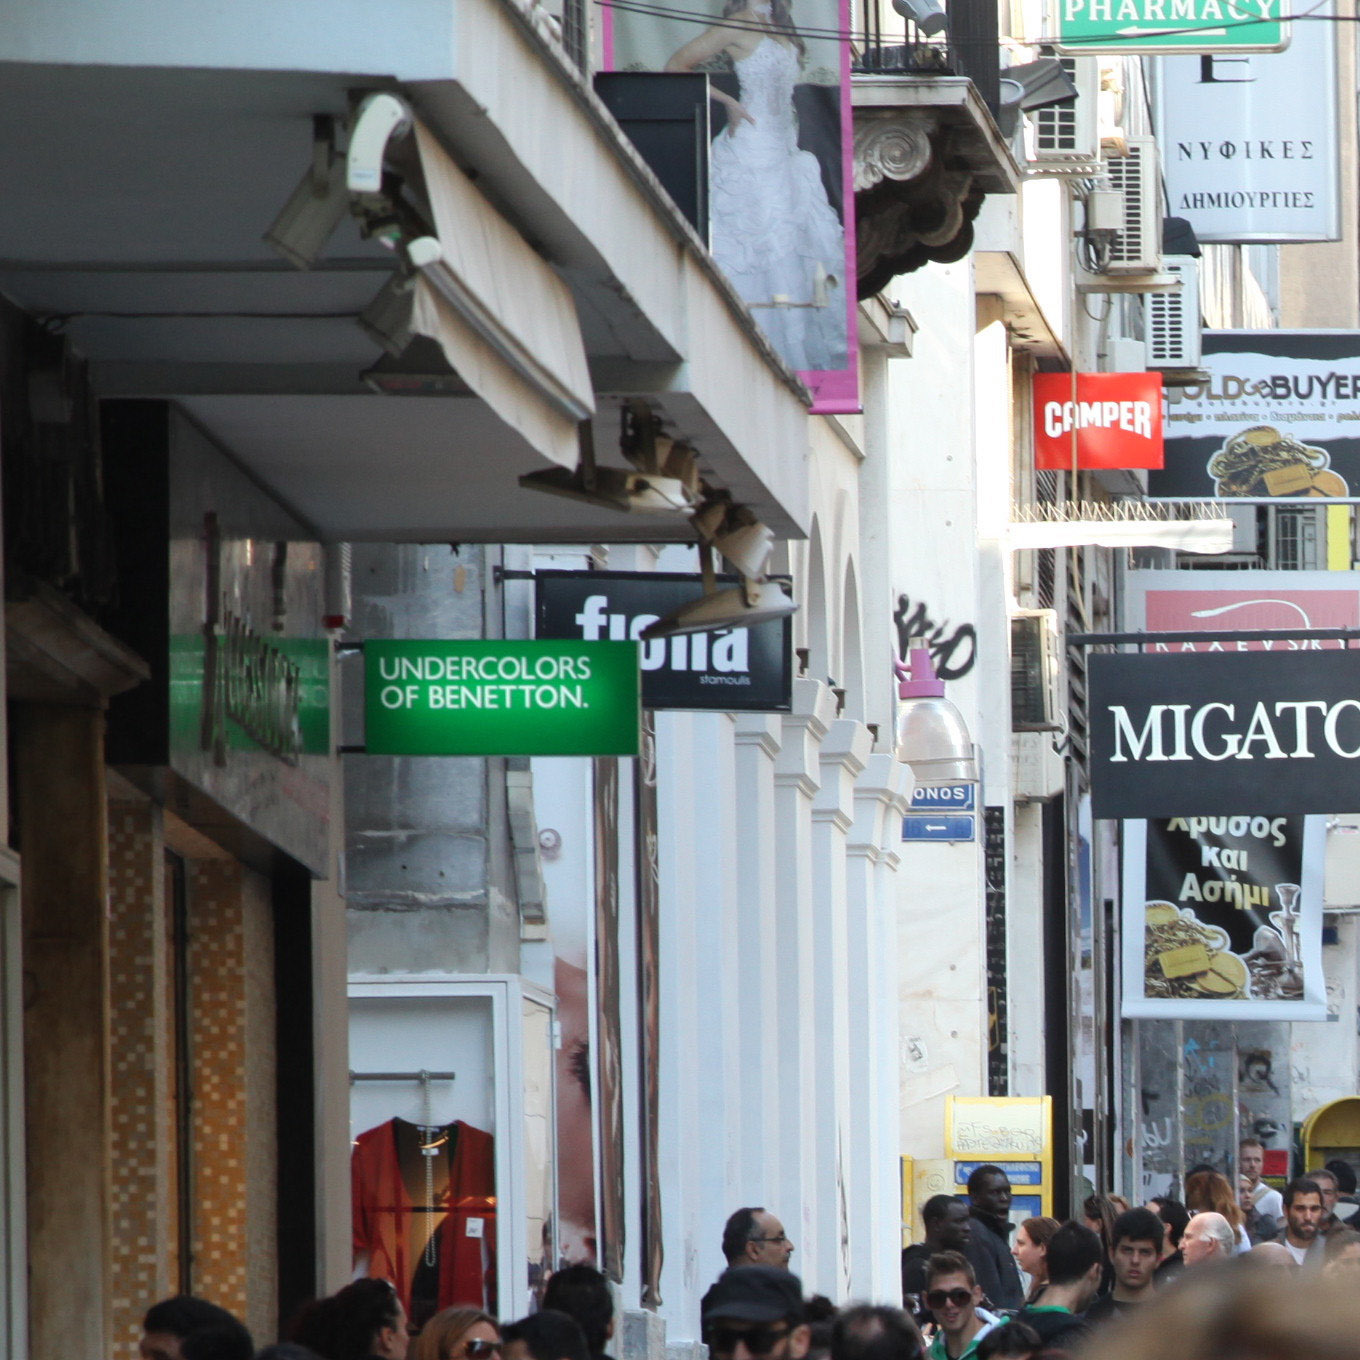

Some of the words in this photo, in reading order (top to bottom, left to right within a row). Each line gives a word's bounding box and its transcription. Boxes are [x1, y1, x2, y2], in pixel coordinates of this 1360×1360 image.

[1177, 141, 1314, 160] ΝΥΦΙΚΕΣ
[1180, 191, 1315, 210] ΔΗΜΙΟΥΡΓΙΕΣ
[1044, 400, 1151, 439] CAMPER
[379, 655, 591, 680] UNDERCOLORS
[381, 685, 419, 709] OF
[428, 684, 589, 709] BENETTON.
[1201, 845, 1249, 871] και
[1178, 872, 1270, 911] Ασήμι
